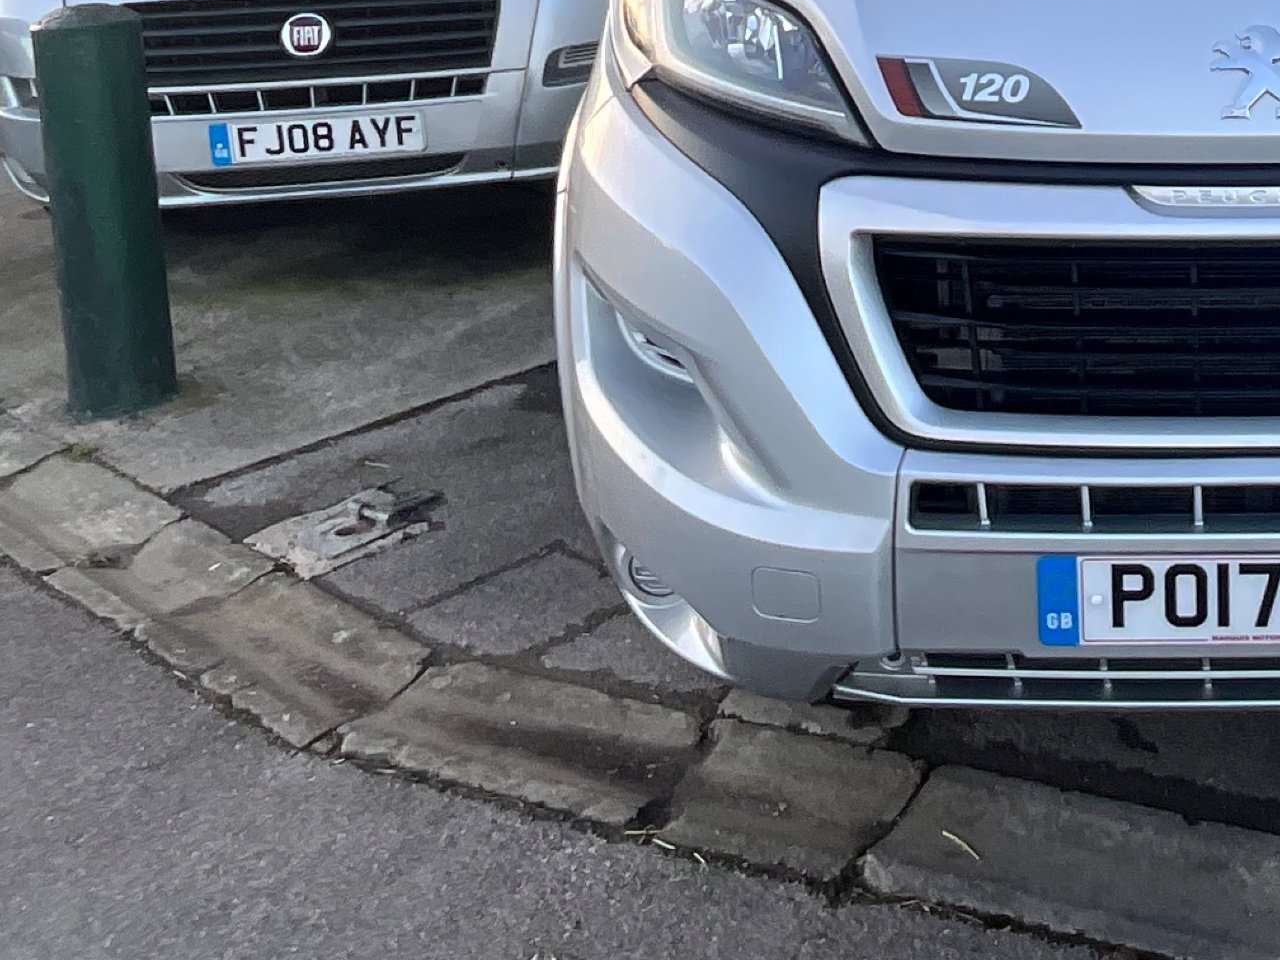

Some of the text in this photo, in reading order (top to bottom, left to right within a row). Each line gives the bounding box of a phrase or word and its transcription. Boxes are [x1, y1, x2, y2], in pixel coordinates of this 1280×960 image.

[293, 25, 321, 46] FIAT
[959, 72, 1030, 103] 120
[237, 122, 334, 158] FJ08
[349, 115, 416, 150] AYF
[1046, 612, 1073, 630] GB
